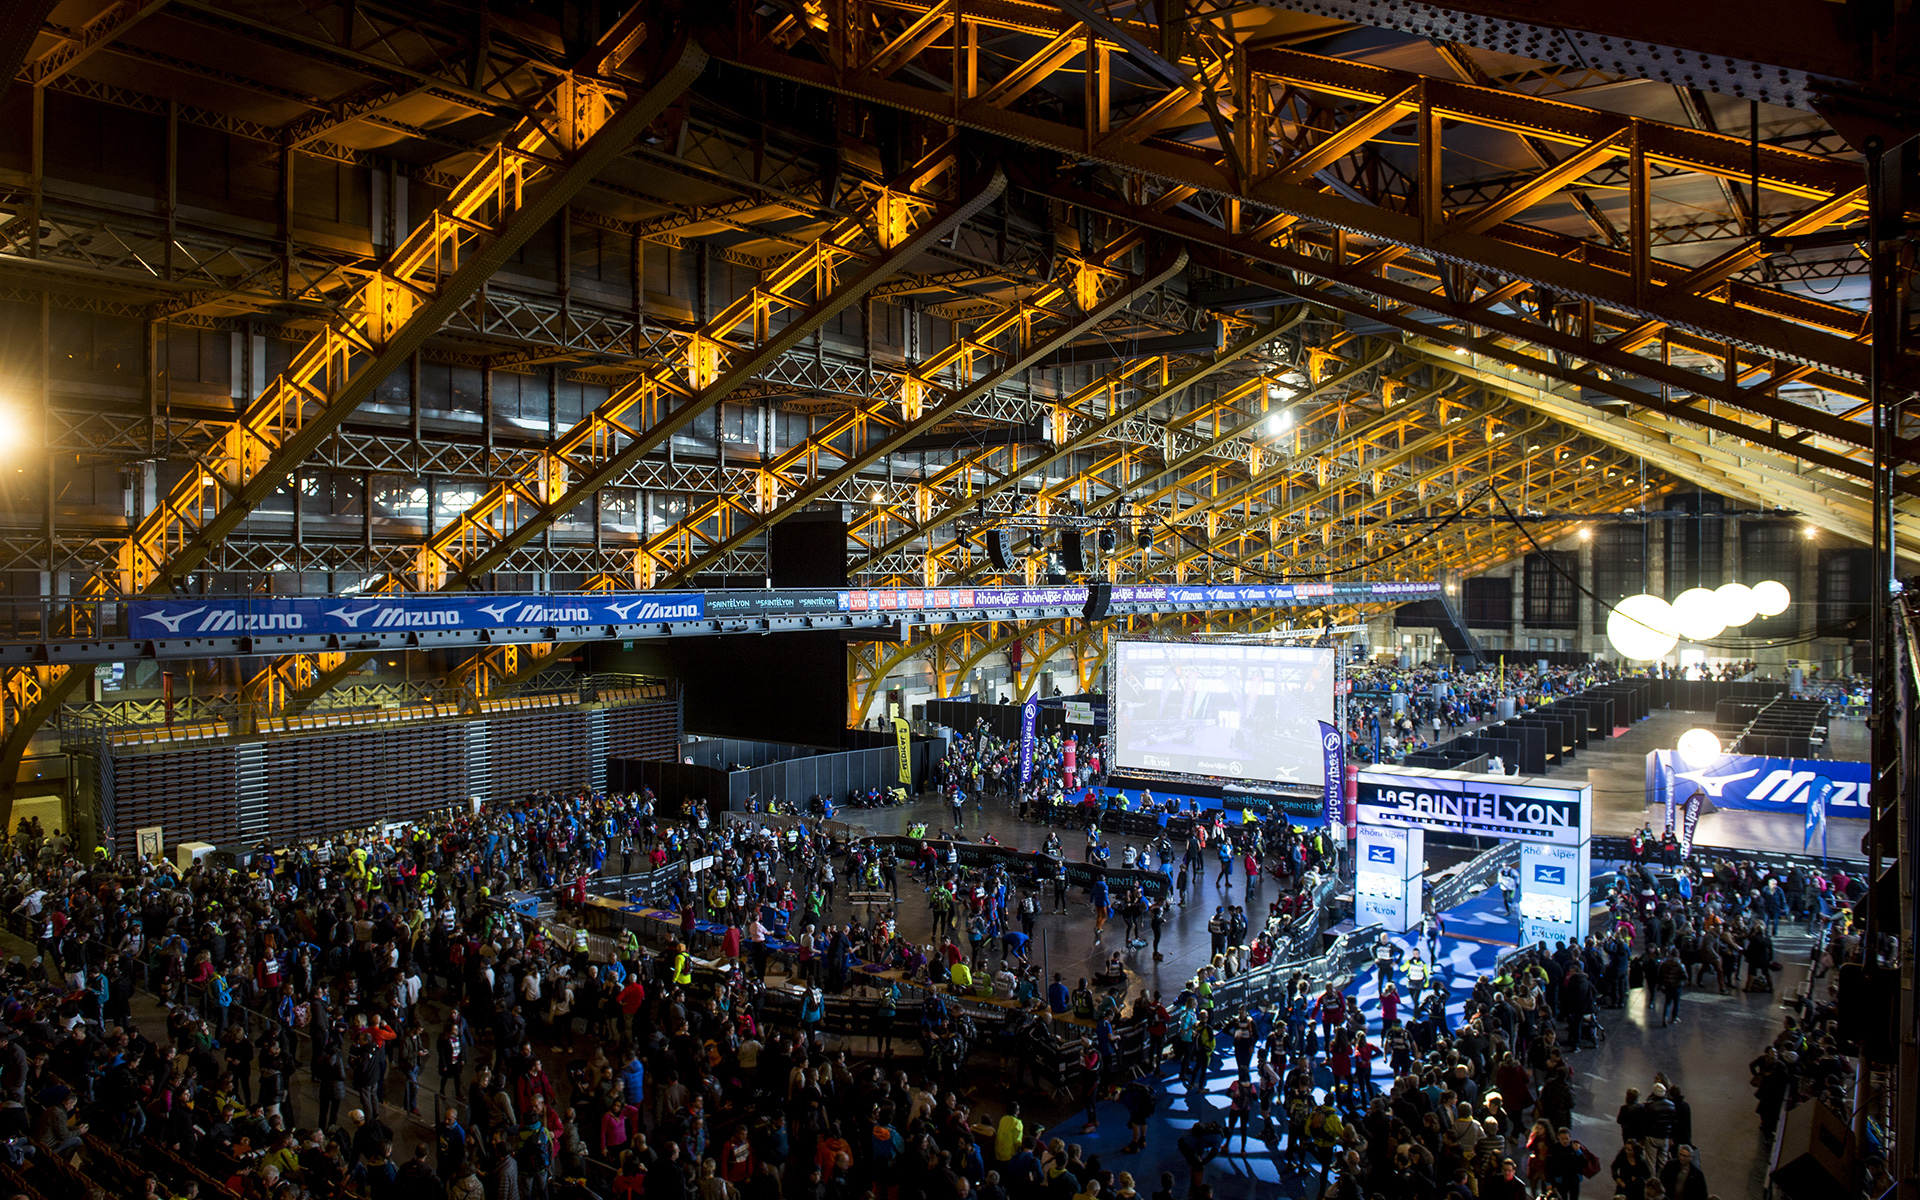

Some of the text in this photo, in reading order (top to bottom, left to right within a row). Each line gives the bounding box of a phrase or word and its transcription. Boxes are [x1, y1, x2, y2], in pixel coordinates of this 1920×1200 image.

[850, 599, 867, 608] LYON
[880, 598, 896, 607] LYON
[908, 598, 923, 606] LYON
[1378, 789, 1569, 827] LA SAINTÉLYON
[1382, 814, 1436, 824] RUNNING
[1482, 825, 1550, 837] NOCTURNE
[1377, 906, 1396, 915] LYON
[1545, 932, 1565, 940] LYON
